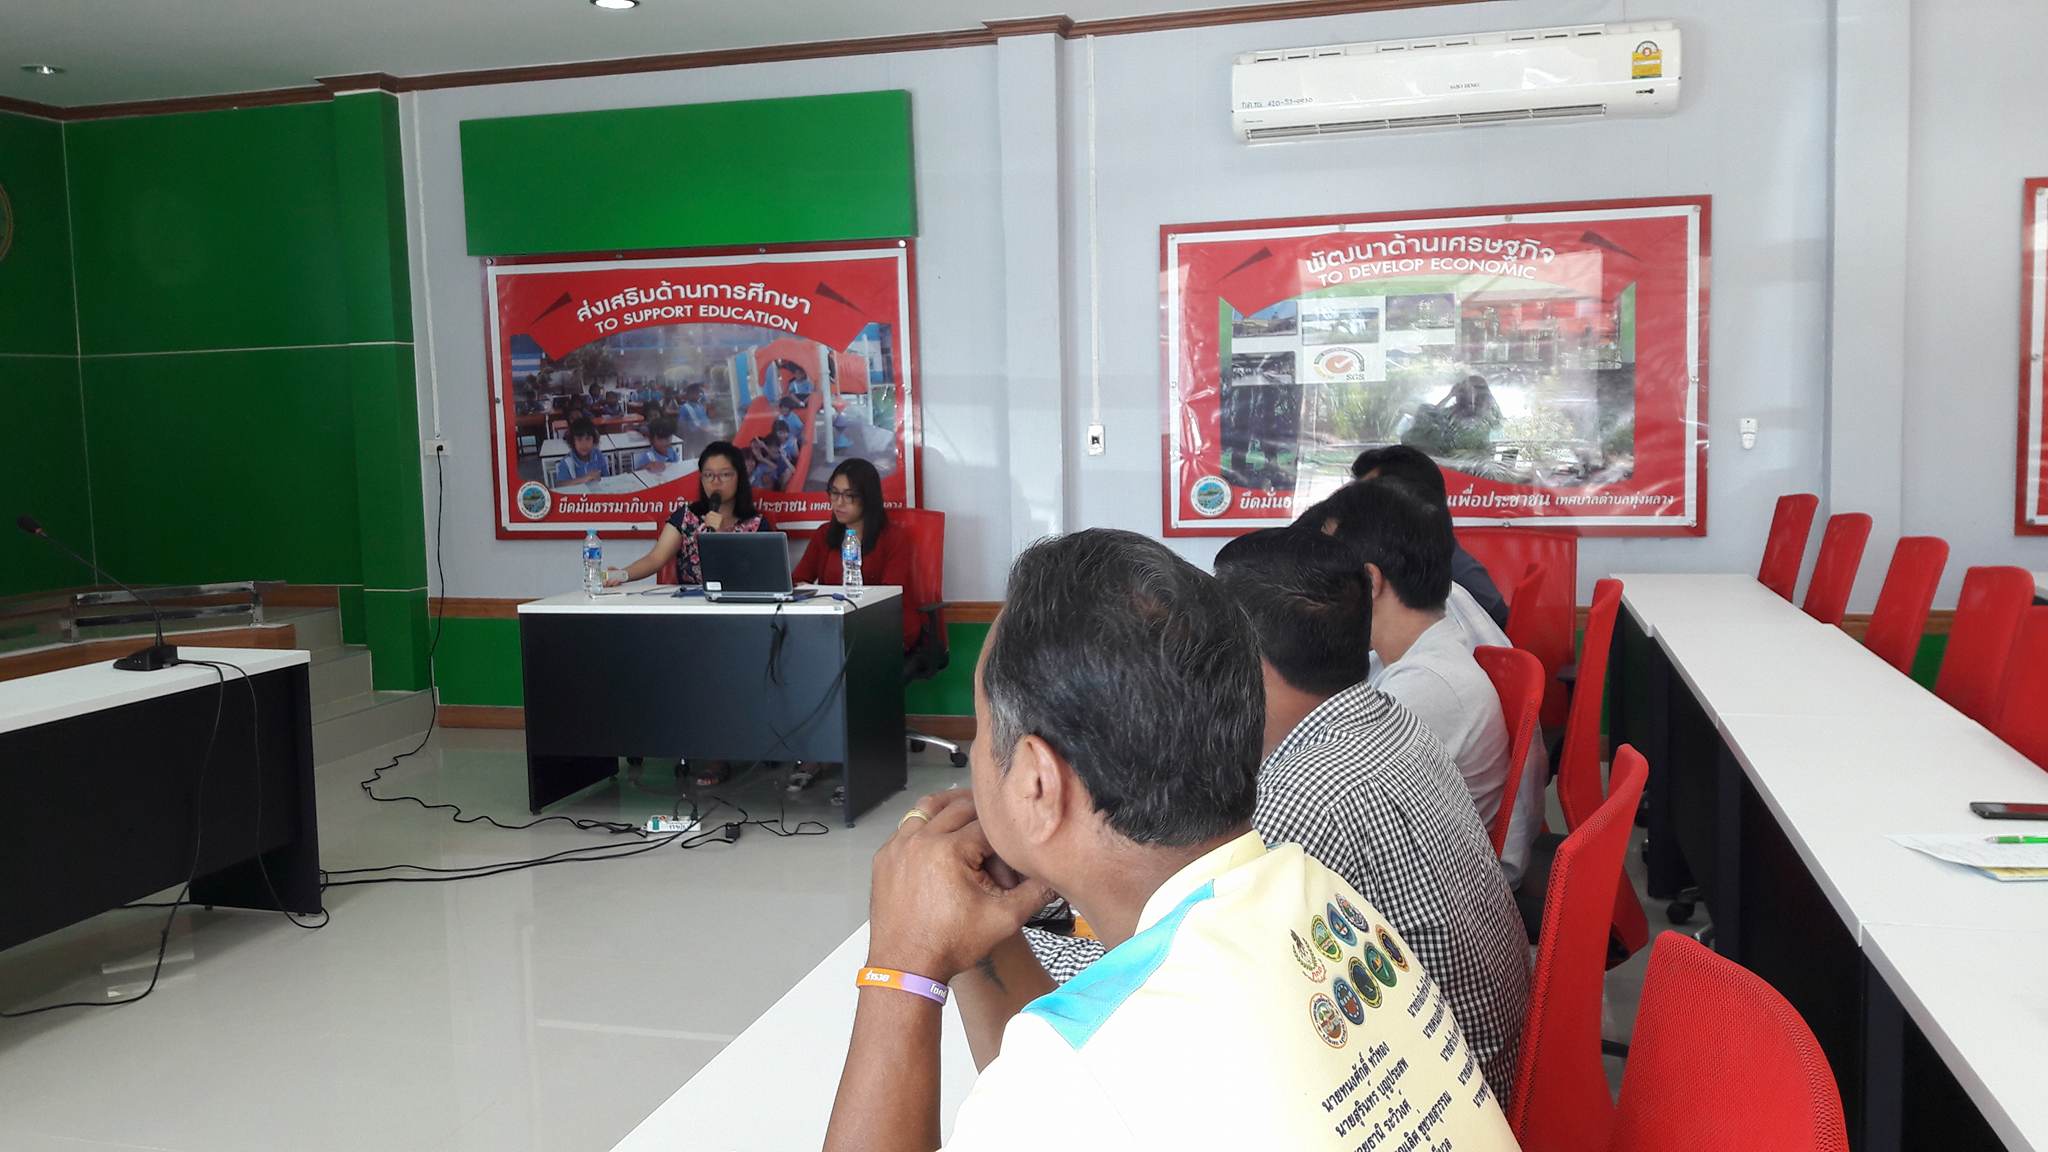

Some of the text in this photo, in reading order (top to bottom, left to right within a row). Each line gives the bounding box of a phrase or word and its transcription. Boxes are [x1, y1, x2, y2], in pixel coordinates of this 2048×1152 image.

[1306, 233, 1556, 274] พัฒนาด้านเศรษฐกิจ
[1318, 257, 1538, 286] TO DEVELOP ECONOMIC
[576, 281, 812, 322] ส่งเสริมด้านการศึกษา
[594, 304, 799, 334] TO SUPPORT EDUCATION
[558, 493, 663, 514] ยึดมั่นธรรมาภิบาล
[1321, 1051, 1371, 1112] นายทนงศักดิ์
[1335, 1080, 1380, 1138] นายสุรินทร์
